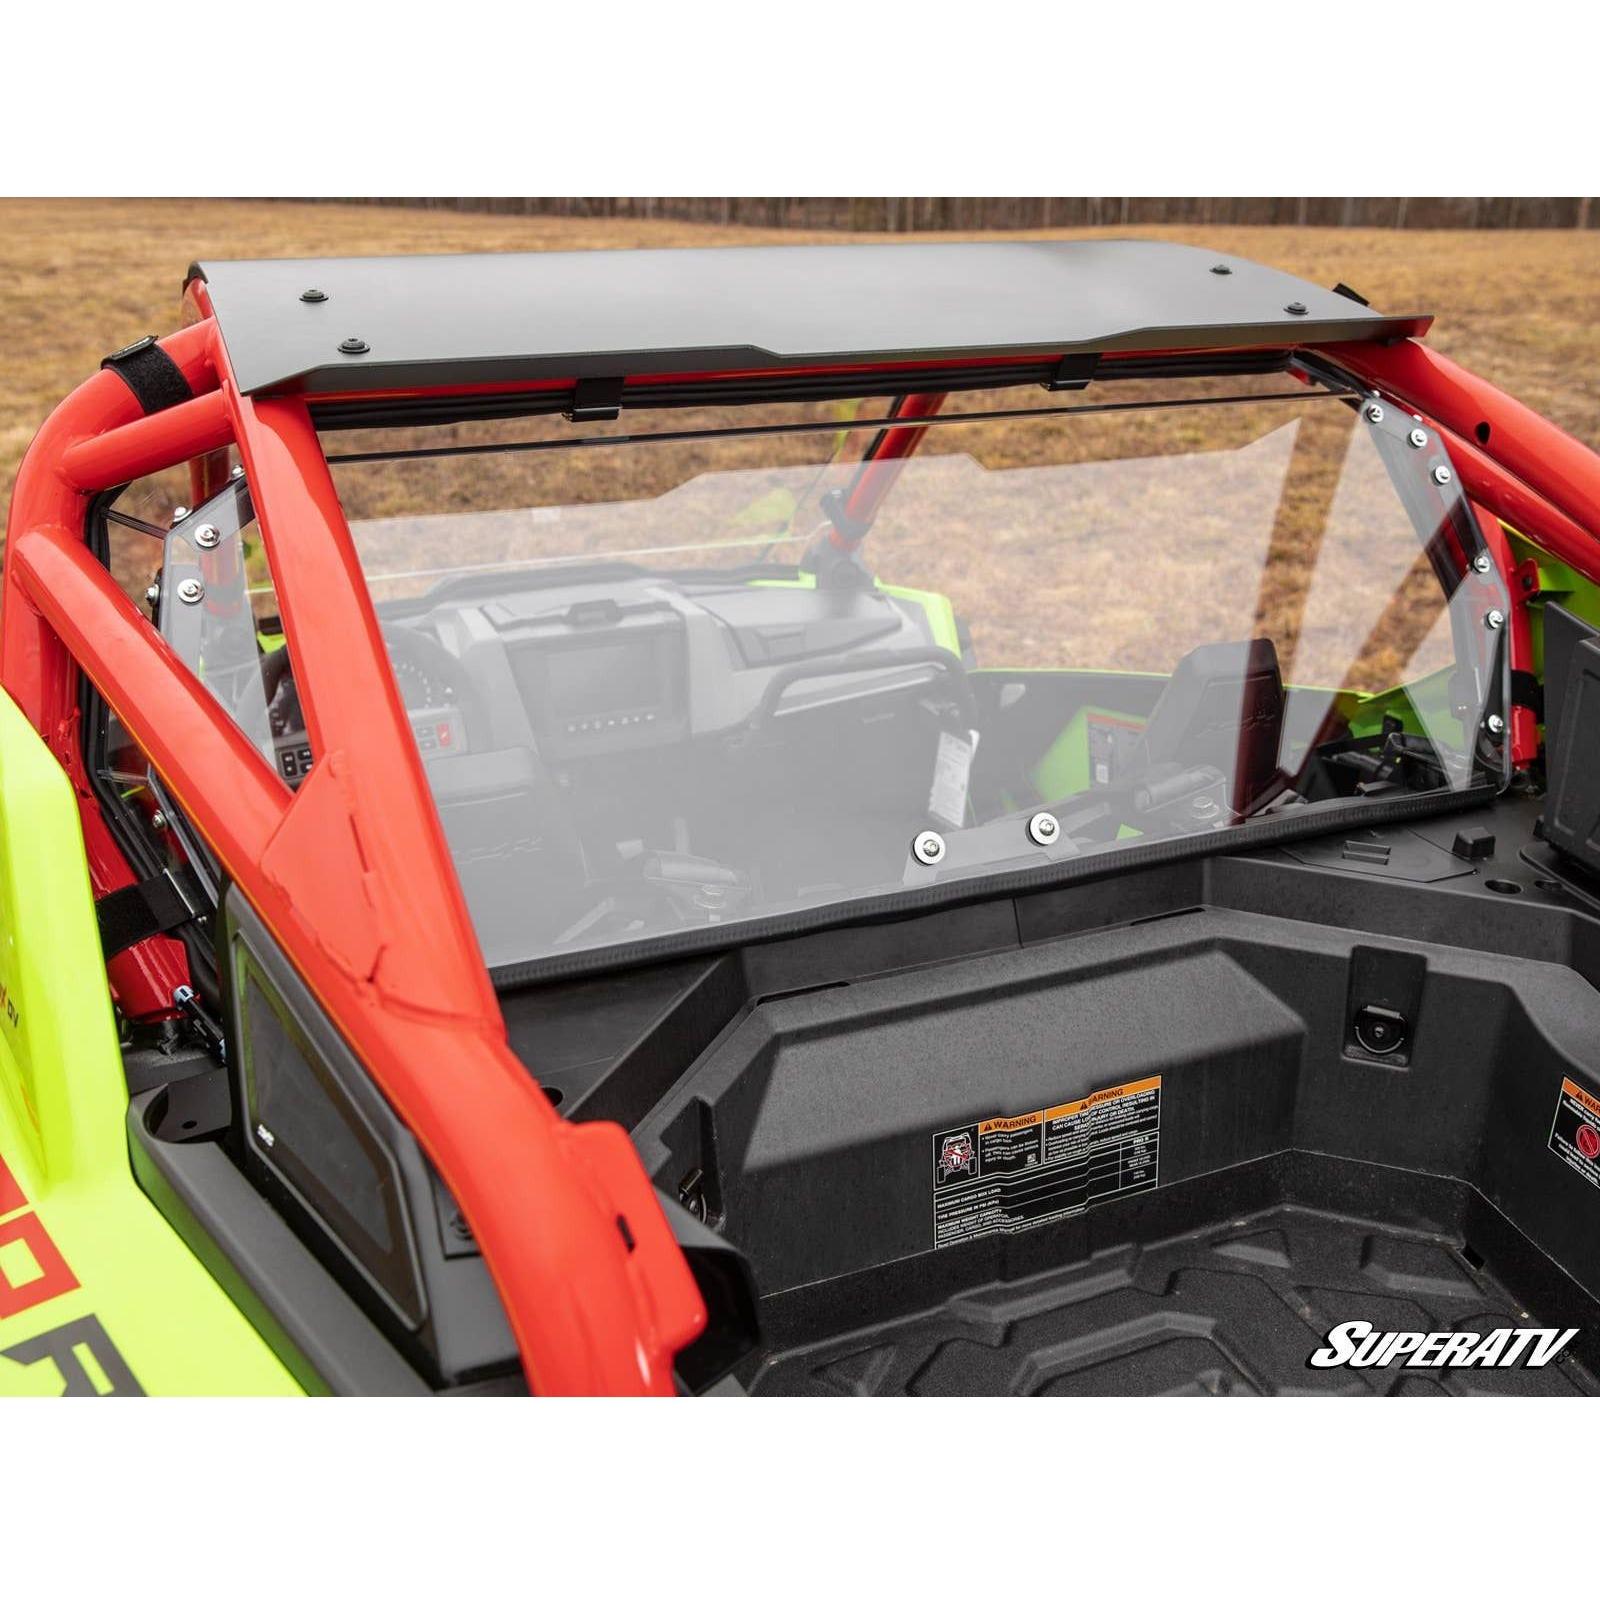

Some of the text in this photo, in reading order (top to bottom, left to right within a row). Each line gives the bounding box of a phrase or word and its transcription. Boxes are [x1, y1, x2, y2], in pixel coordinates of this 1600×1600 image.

[993, 1115, 1036, 1128] WARNING
[1064, 1119, 1081, 1128] CAUSE
[937, 1199, 961, 1209] MAXIMUM
[961, 1194, 977, 1202] CARGO
[987, 1187, 1001, 1195] LOAD
[949, 1206, 973, 1216] PRESSURE
[938, 1220, 960, 1229] MAXIMUM
[961, 1214, 979, 1222] WEIGHT
